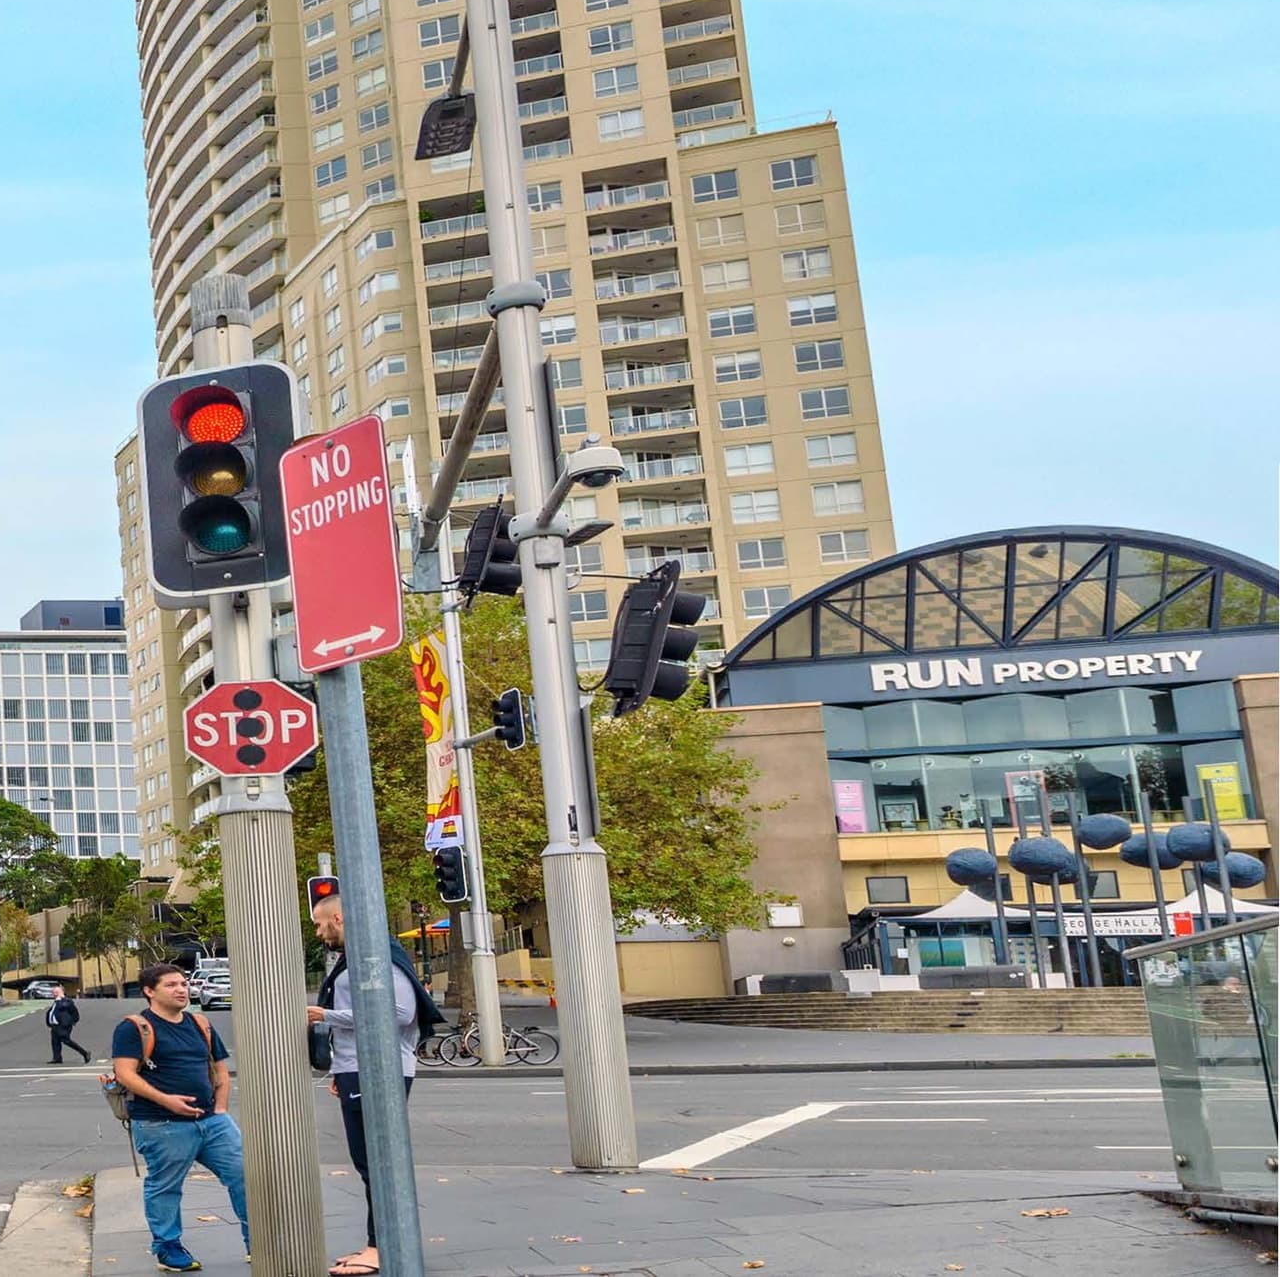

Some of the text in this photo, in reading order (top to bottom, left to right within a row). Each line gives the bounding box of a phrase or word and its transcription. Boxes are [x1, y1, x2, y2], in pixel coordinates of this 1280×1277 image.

[310, 444, 352, 488] NO
[290, 476, 385, 536] STOPPING
[870, 650, 1202, 691] RUN PROPERTY
[193, 710, 307, 746] STOP
[1064, 919, 1110, 928] EOGE
[1115, 918, 1148, 928] HALL
